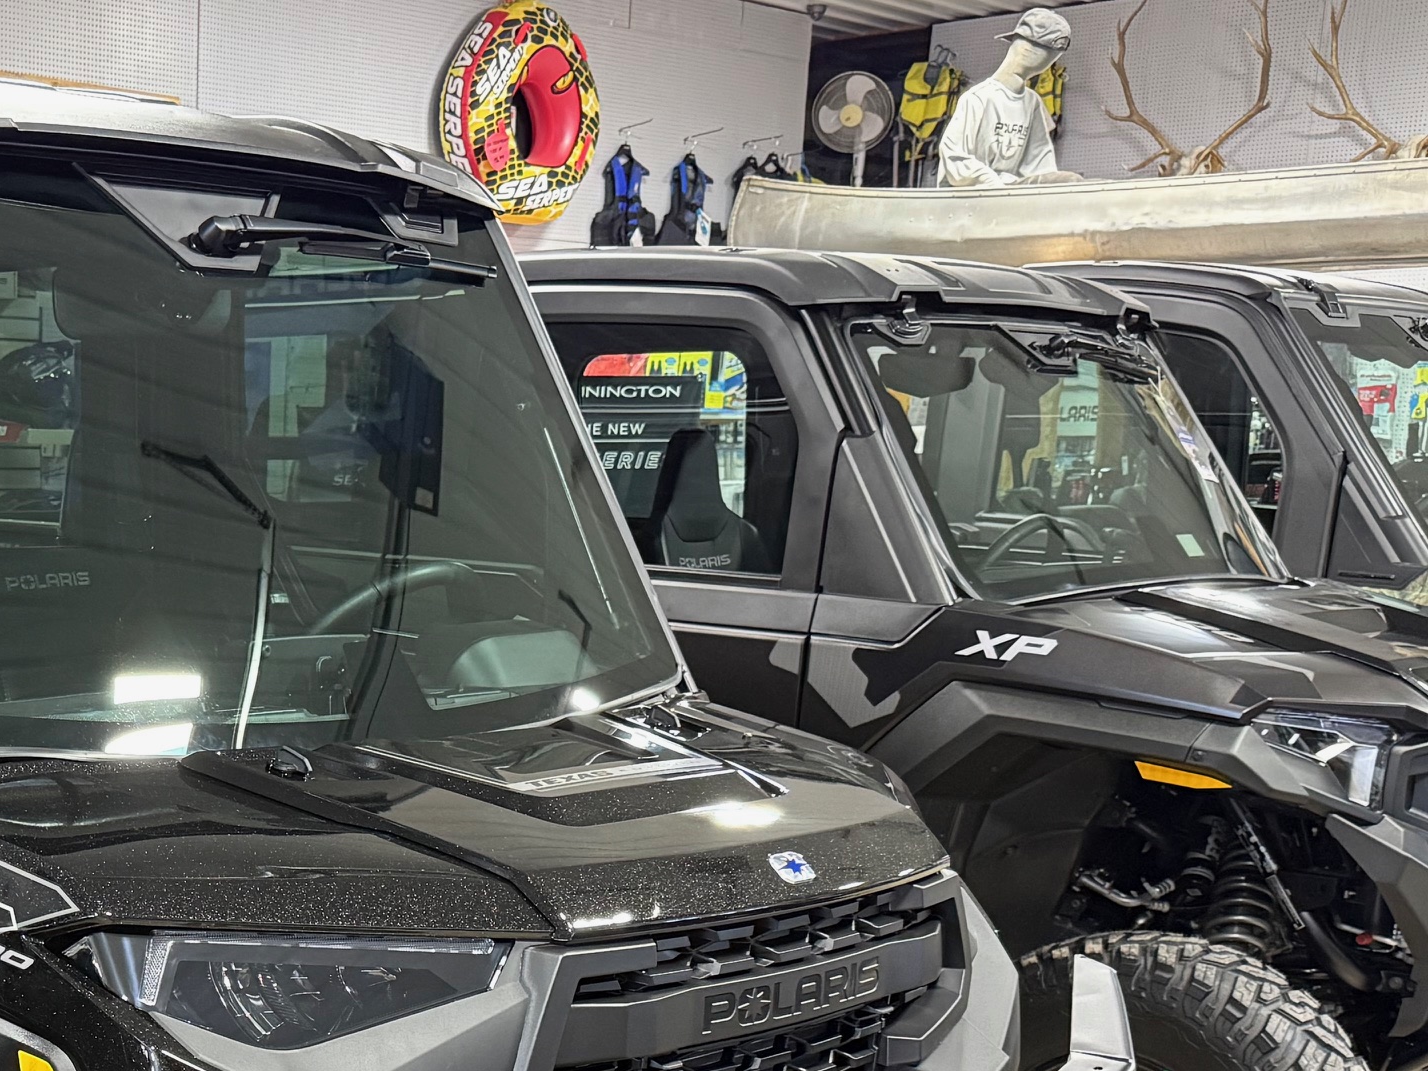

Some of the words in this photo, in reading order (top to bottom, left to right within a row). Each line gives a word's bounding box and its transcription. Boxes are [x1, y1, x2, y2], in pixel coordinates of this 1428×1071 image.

[454, 21, 493, 68] SEA
[475, 46, 512, 103] SEA
[493, 173, 548, 200] SEA
[581, 385, 681, 398] NINGTON
[607, 422, 645, 435] NEW
[597, 451, 666, 469] ERIE
[679, 554, 731, 569] POLARIS
[5, 571, 91, 592] POLARIS
[954, 630, 1058, 661] XP
[702, 956, 880, 1035] POLARIS
